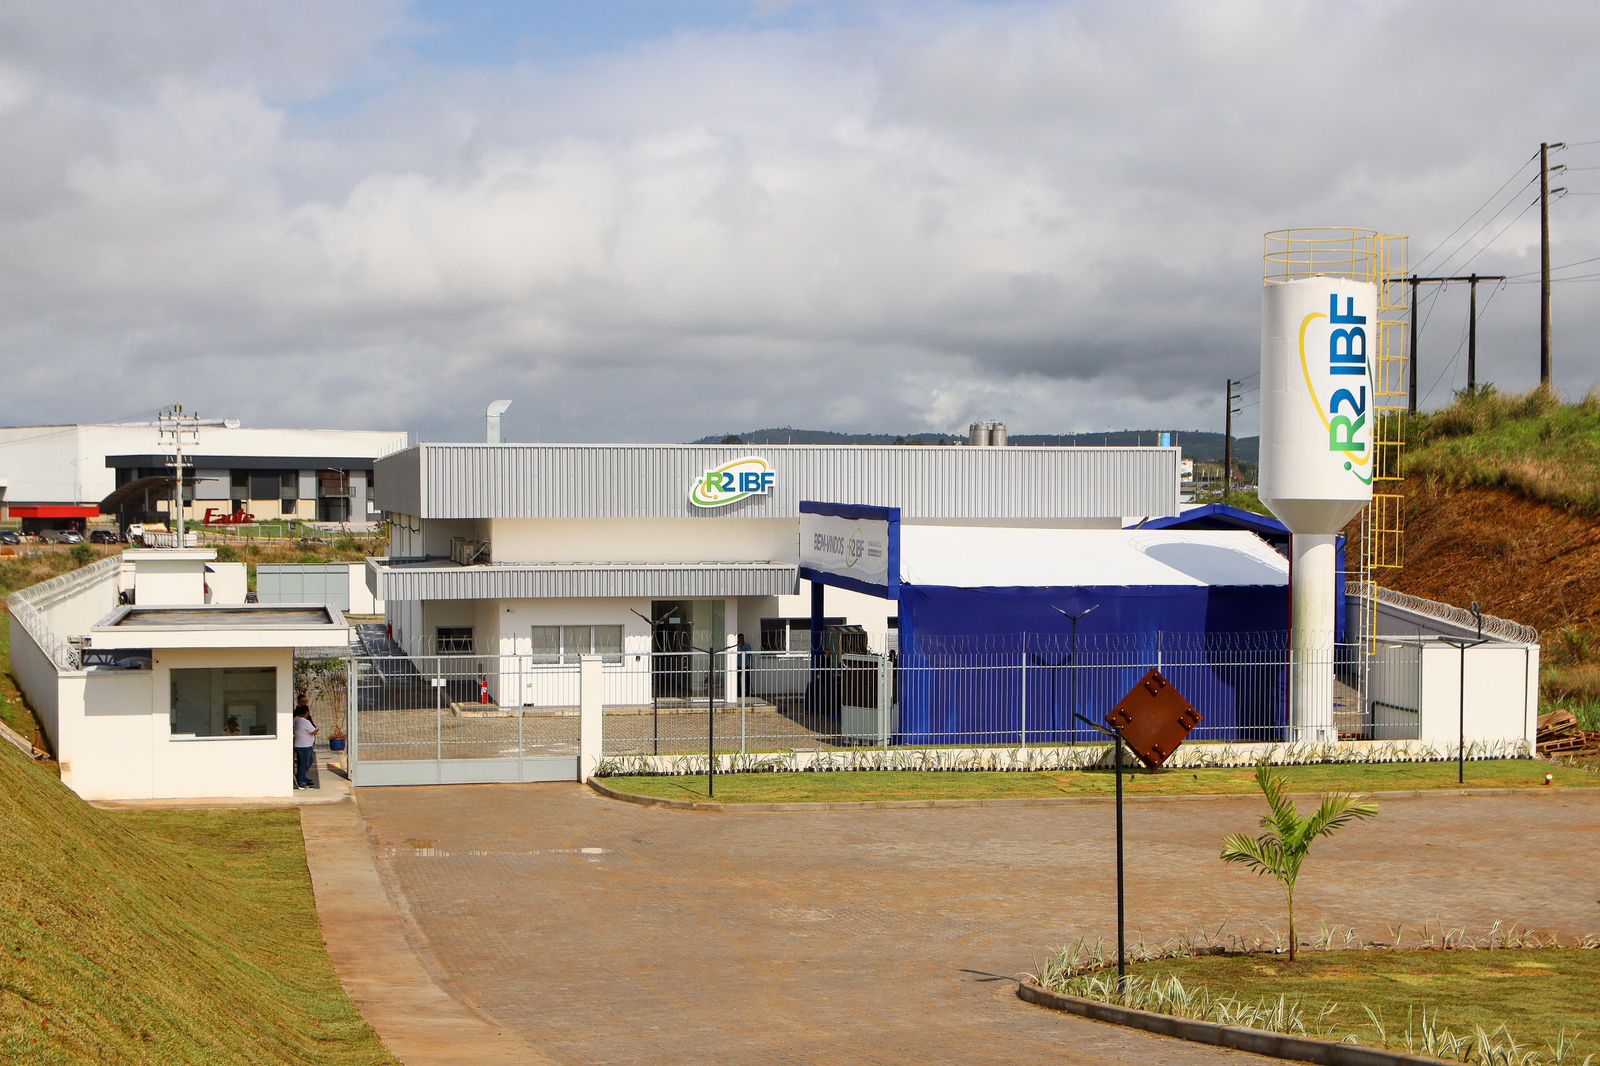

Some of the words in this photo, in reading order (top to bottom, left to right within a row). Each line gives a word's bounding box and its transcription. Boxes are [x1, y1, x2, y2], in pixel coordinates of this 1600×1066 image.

[1329, 293, 1366, 376] IBF
[1329, 385, 1366, 452] R2
[706, 471, 736, 493] R2
[739, 471, 775, 493] IBF
